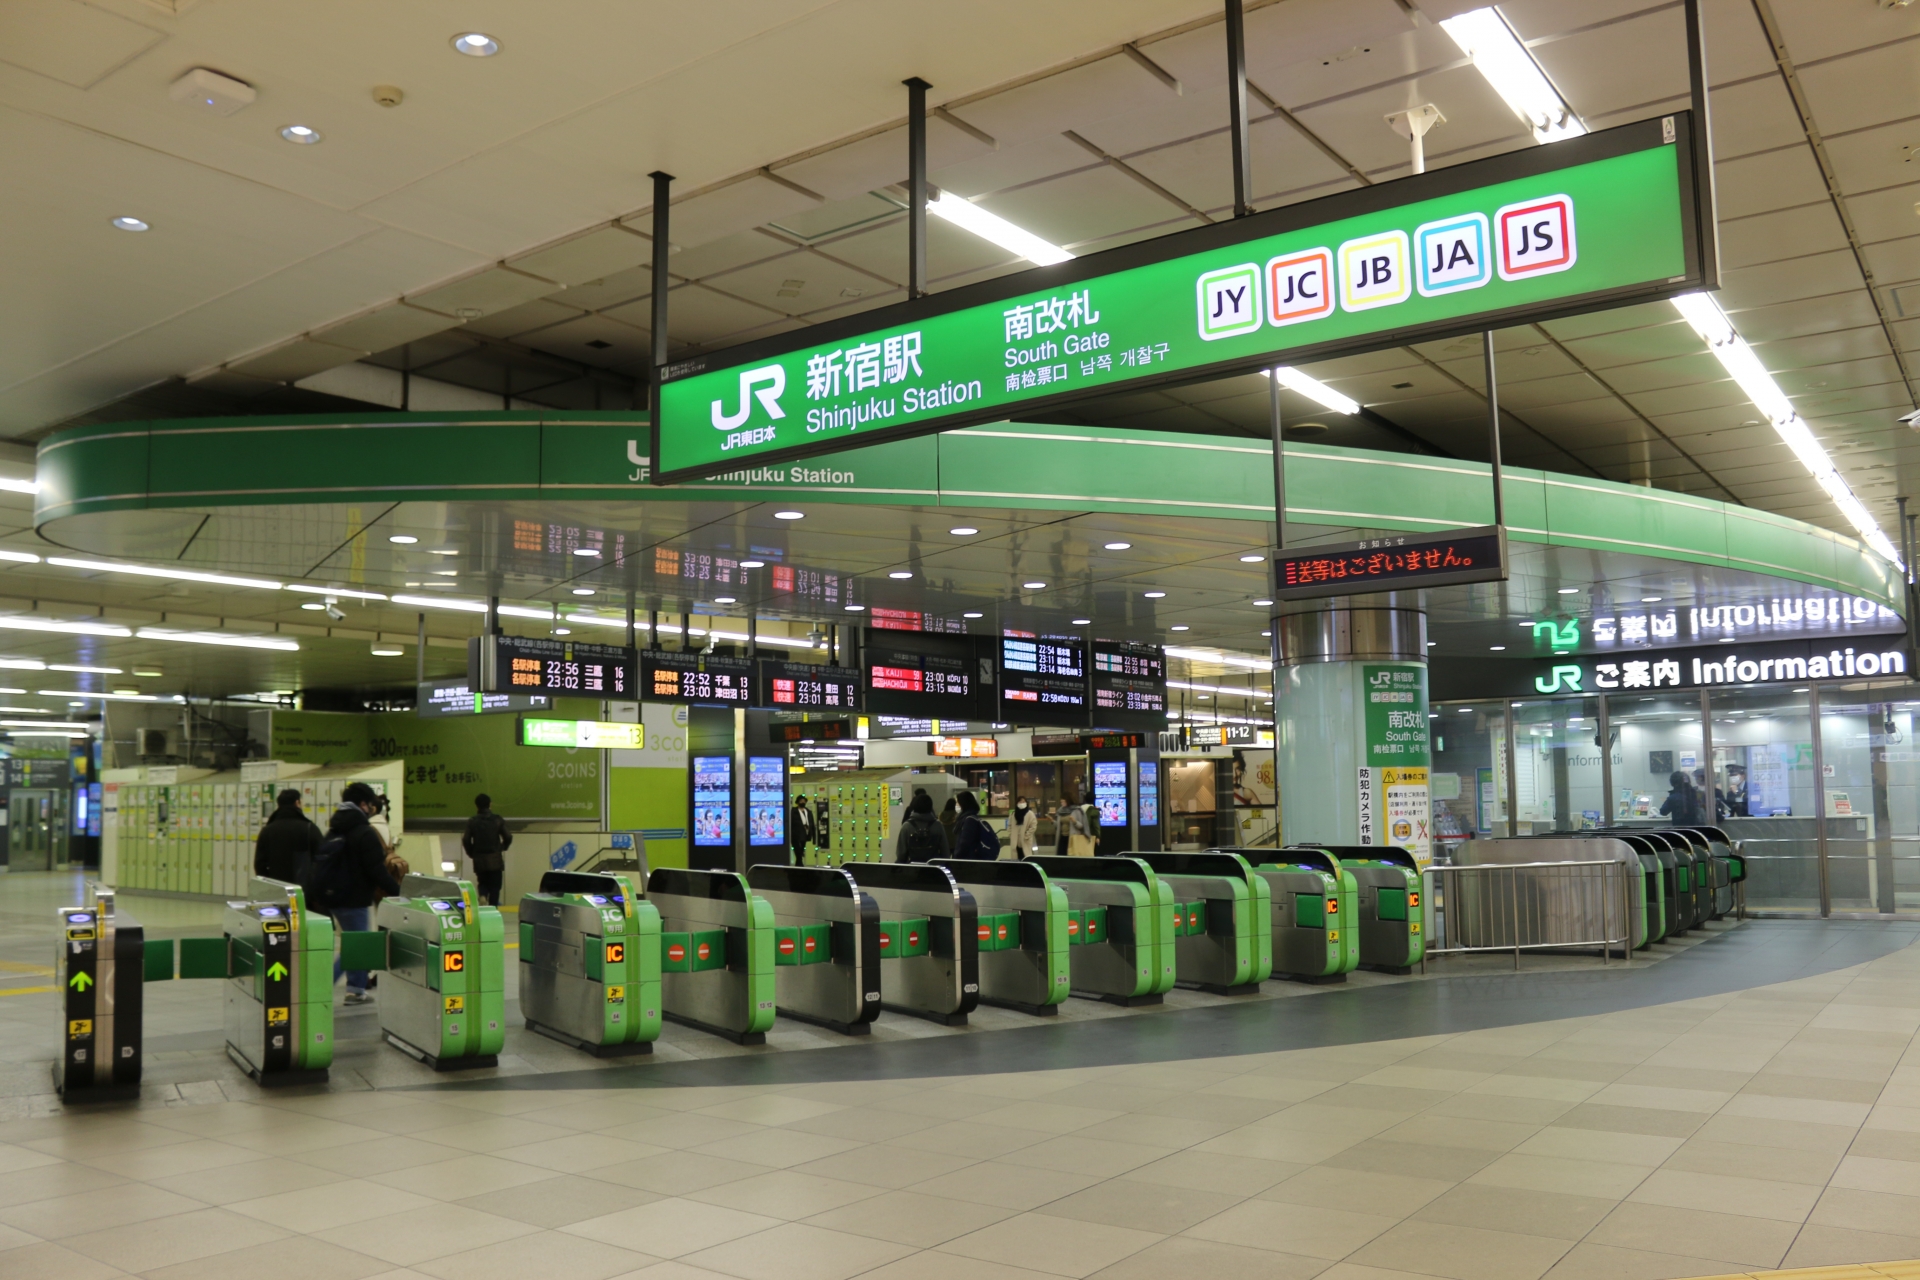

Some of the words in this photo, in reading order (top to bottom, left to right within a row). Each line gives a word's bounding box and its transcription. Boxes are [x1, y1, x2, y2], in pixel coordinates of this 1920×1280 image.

[1517, 221, 1554, 256] JS
[1432, 239, 1475, 273] JA
[1356, 256, 1392, 289] JB
[1284, 271, 1318, 303] JC
[1213, 285, 1247, 318] JY
[1003, 289, 1100, 343] 南改札
[1005, 340, 1058, 368] South
[1063, 329, 1110, 357] Gate
[806, 331, 924, 401] 新宿駅
[1079, 356, 1113, 377] 남쪽
[1119, 342, 1172, 367] 개찰구
[1005, 362, 1069, 393] 南检票口
[710, 364, 787, 431] JR
[806, 394, 896, 435] Shinjuku
[902, 378, 983, 415] Station
[720, 426, 777, 451] JR東日本
[790, 467, 855, 485] Station
[1358, 537, 1406, 550] お知らせ
[547, 661, 579, 675] 22:56
[615, 667, 624, 679] 16
[1596, 659, 1681, 689] ご案内
[1693, 647, 1905, 685] Information
[547, 675, 579, 689] 23:02
[615, 680, 624, 692] 16
[683, 672, 710, 685] 22:52
[715, 675, 730, 687] 千葉
[740, 677, 748, 688] 13
[925, 671, 945, 683] 23:00
[1370, 672, 1391, 684] JR
[1393, 672, 1415, 682] 新宿駅
[1534, 664, 1582, 694] JR
[683, 685, 711, 698] 23:00
[715, 688, 738, 700] 津田沼
[740, 689, 748, 700] 13
[798, 681, 822, 693] 22:54
[847, 685, 854, 695] 12
[914, 682, 920, 691] 9
[925, 682, 945, 694] 23:15
[963, 686, 968, 695] 9
[798, 693, 821, 705] 23:01
[847, 696, 854, 707] 12
[1041, 693, 1057, 703] 22:58
[1388, 711, 1425, 728] 南改札
[526, 722, 542, 741] 14
[629, 728, 642, 745] 13
[1386, 731, 1411, 742] South
[1413, 731, 1426, 742] Gate
[935, 741, 944, 753] 12
[548, 762, 597, 779] 3COINS
[1360, 768, 1372, 845] 防犯カメラ作動
[1321, 873, 1335, 883] IC
[1327, 900, 1338, 913] IC
[1409, 894, 1419, 906] IC
[441, 915, 464, 930] IC
[602, 908, 624, 922] IC
[445, 931, 463, 941] 専用
[606, 924, 623, 934] 専用
[444, 953, 463, 971] IC
[606, 945, 623, 962] IC
